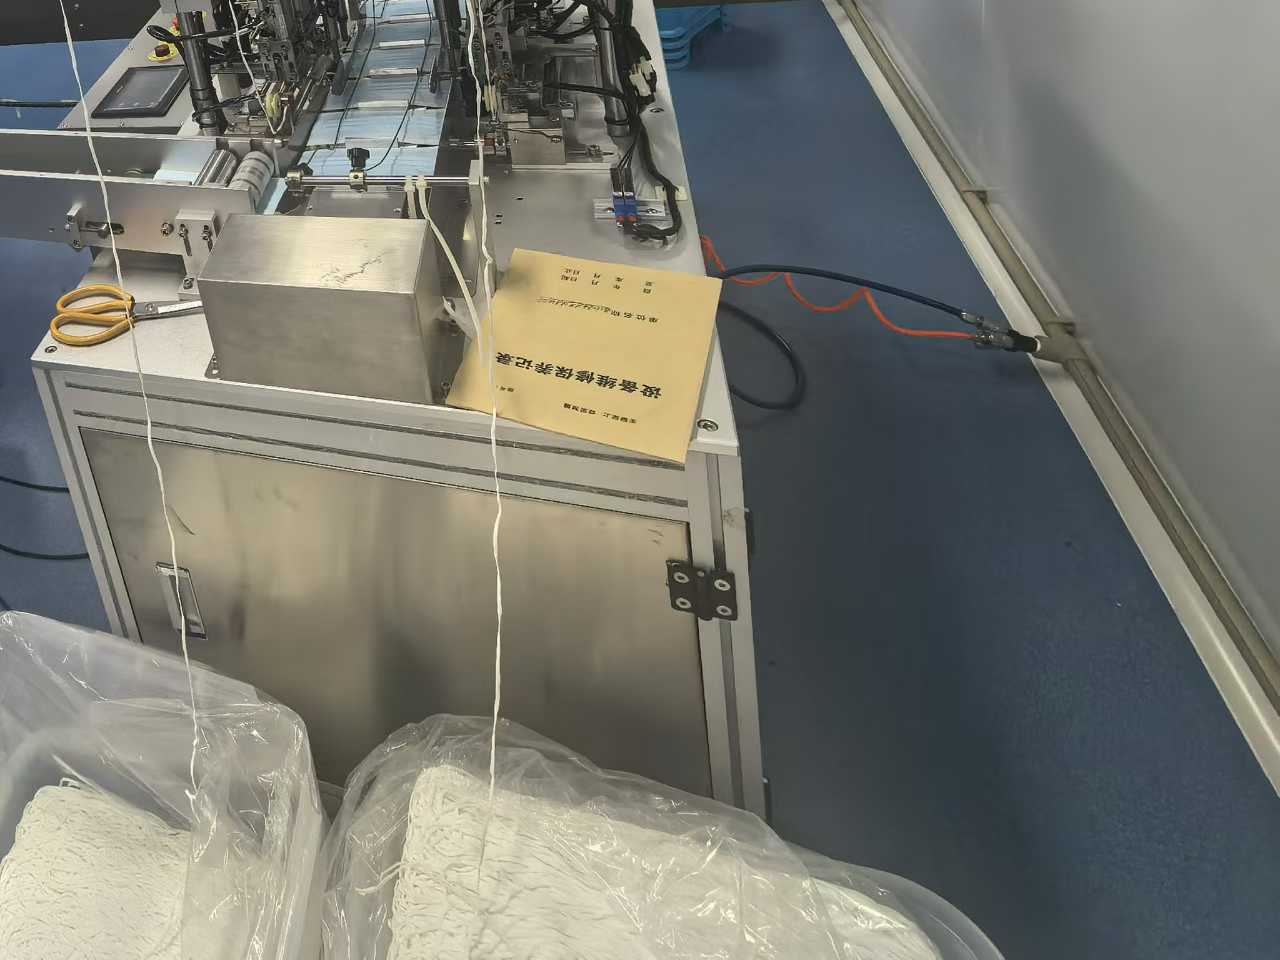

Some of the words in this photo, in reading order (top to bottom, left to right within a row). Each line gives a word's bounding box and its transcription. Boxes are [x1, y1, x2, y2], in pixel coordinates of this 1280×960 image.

[495, 351, 662, 399] 设备维修保养记录
